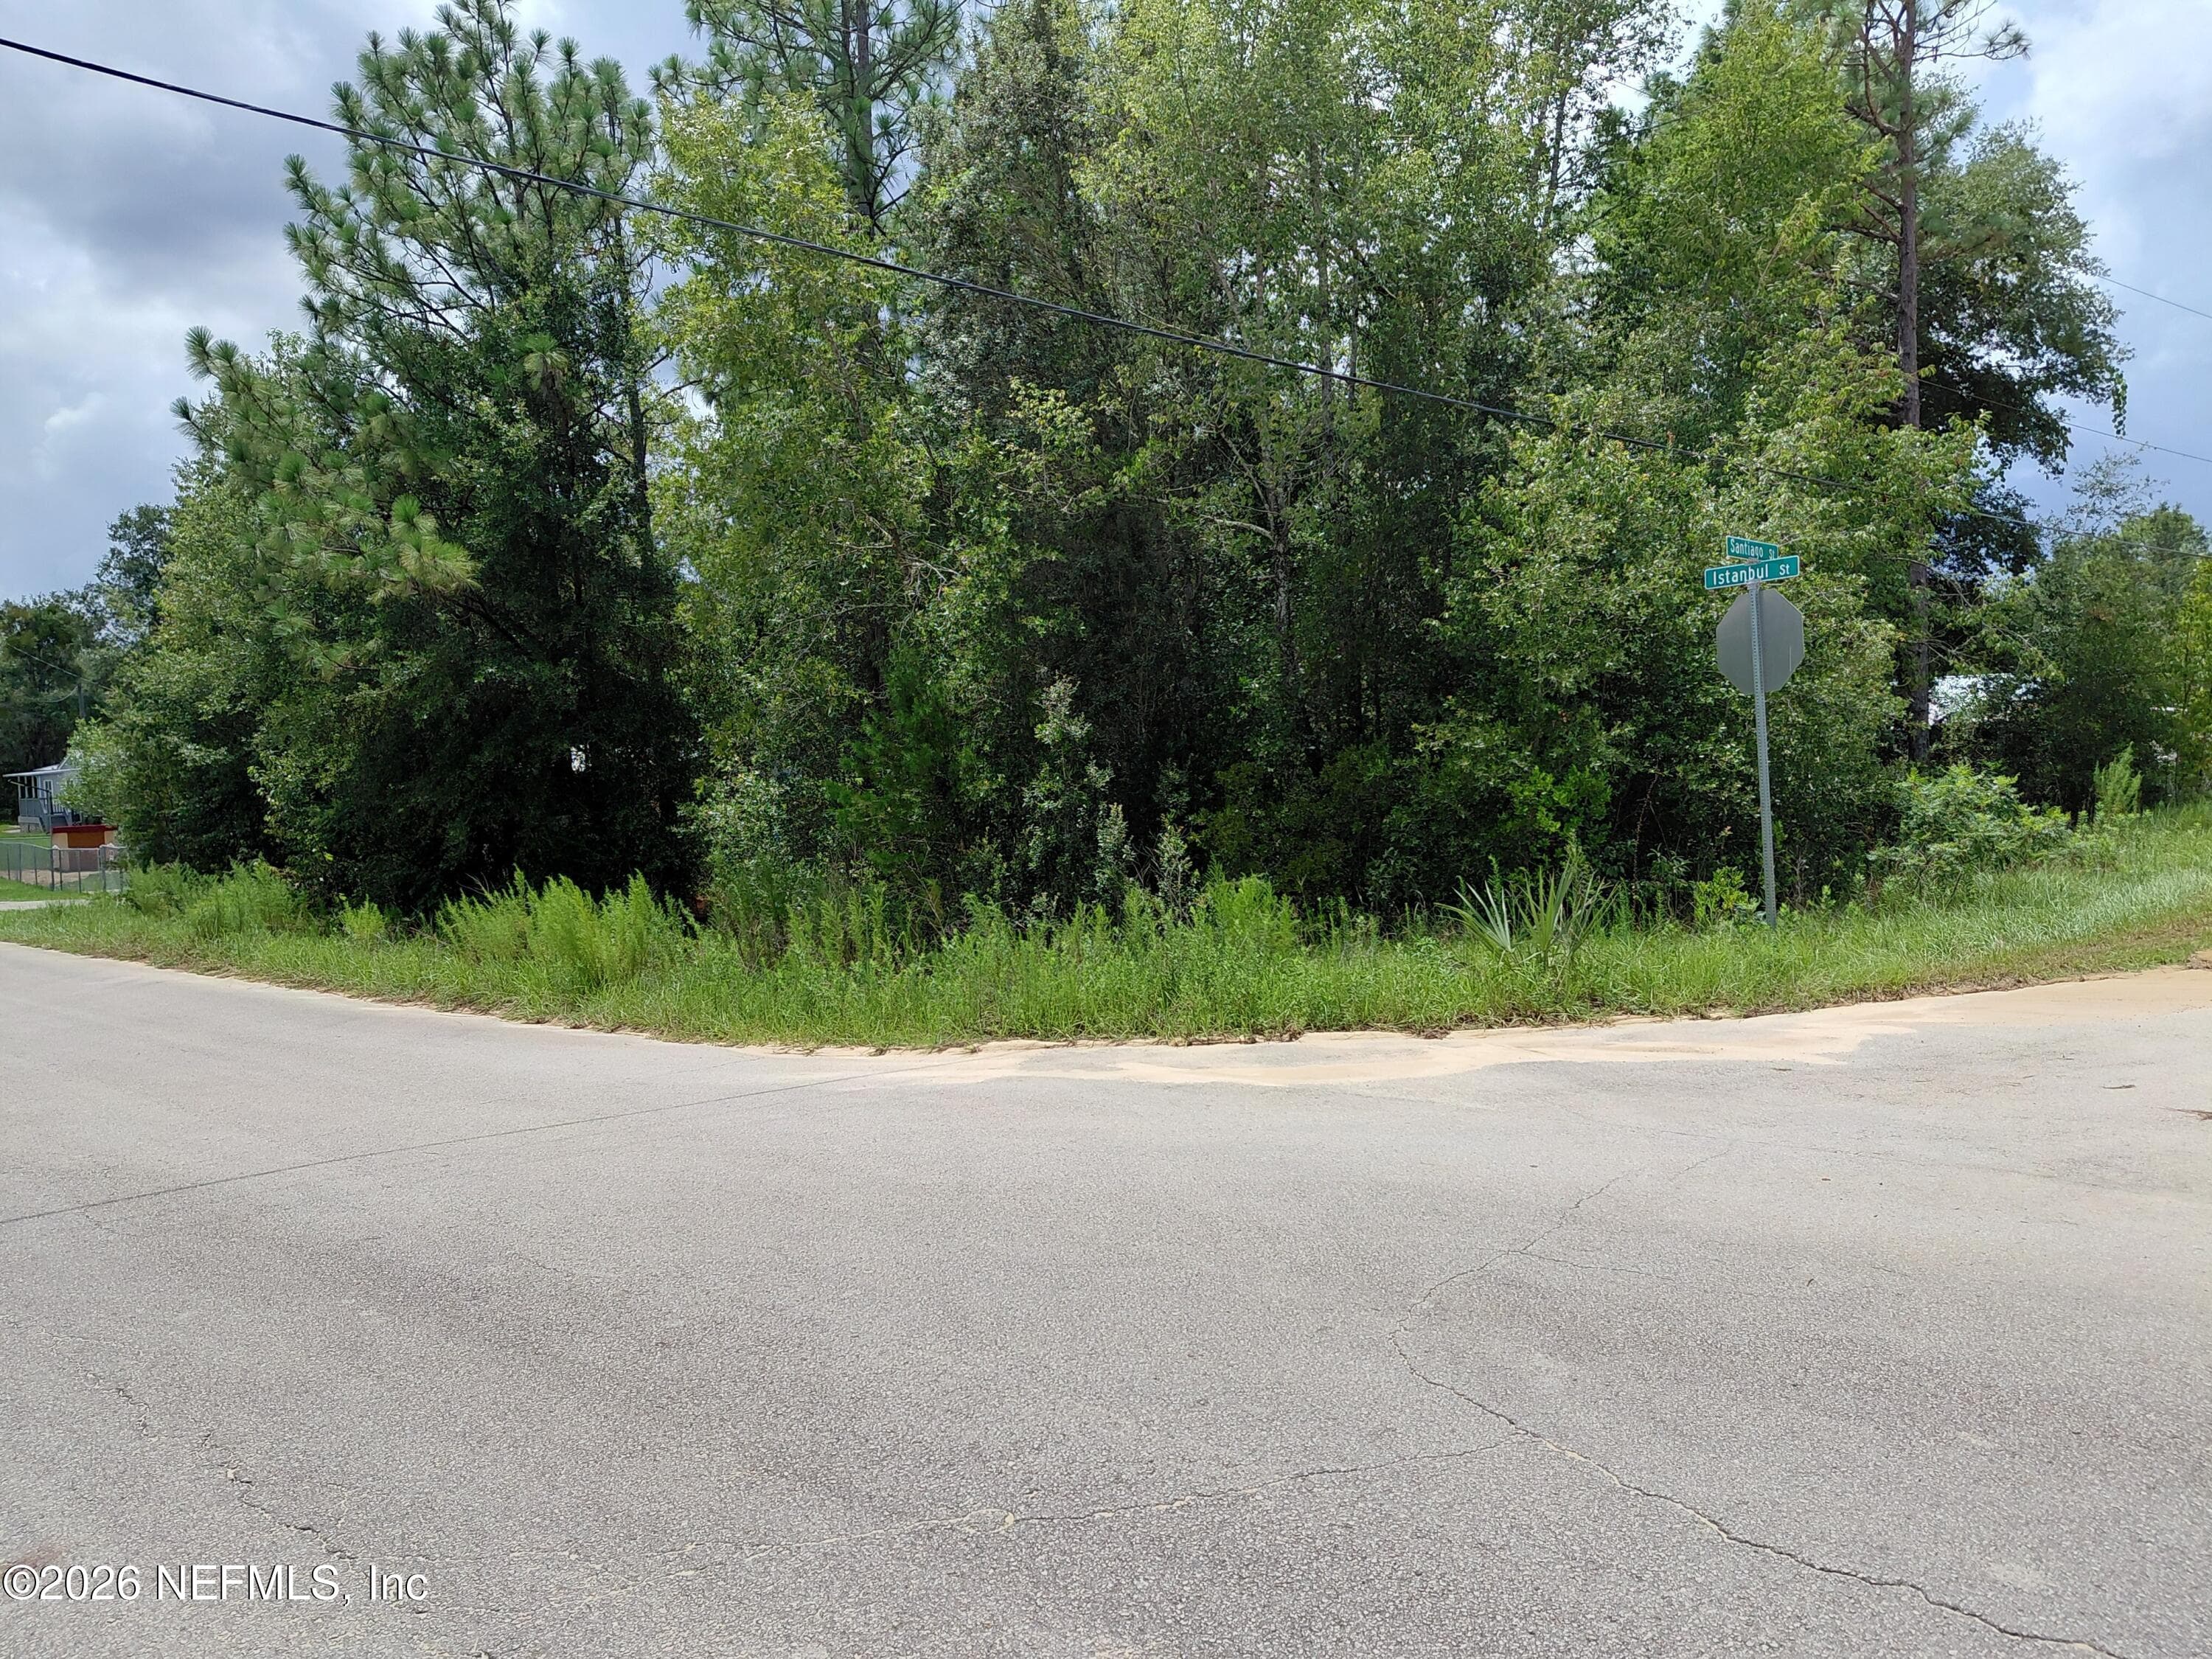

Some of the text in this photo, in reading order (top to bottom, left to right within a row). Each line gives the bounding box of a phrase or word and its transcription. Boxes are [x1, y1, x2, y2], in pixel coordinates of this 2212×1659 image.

[1730, 538, 1775, 560] Santiago St
[1713, 563, 1790, 585] Istanbul St
